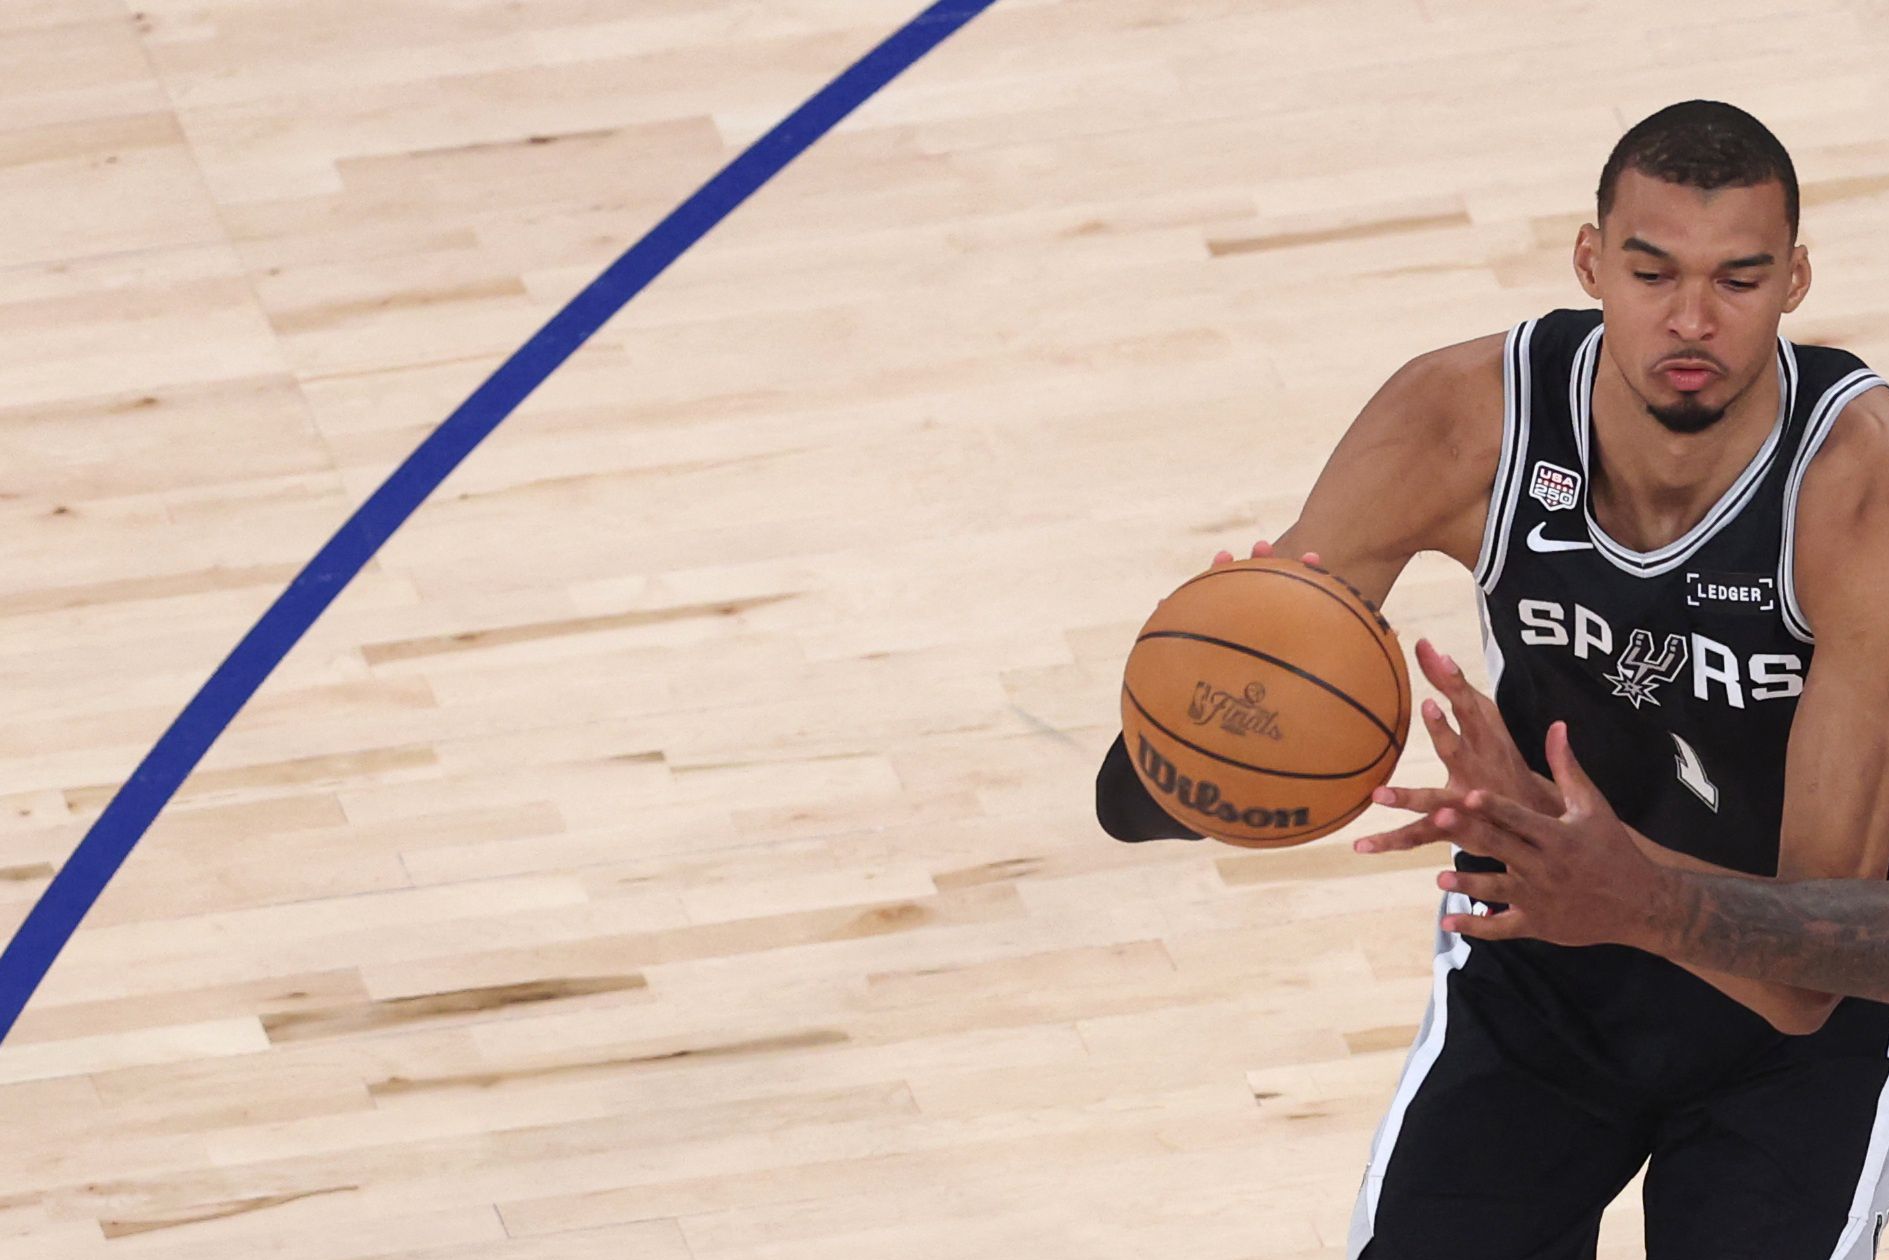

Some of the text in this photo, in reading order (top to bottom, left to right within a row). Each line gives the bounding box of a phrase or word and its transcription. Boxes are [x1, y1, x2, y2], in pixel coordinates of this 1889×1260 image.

[1540, 468, 1574, 488] USA
[1534, 484, 1573, 505] 250
[1697, 583, 1761, 602] LEDGER
[1518, 599, 1804, 710] SPURS
[1138, 733, 1310, 828] Wilson
